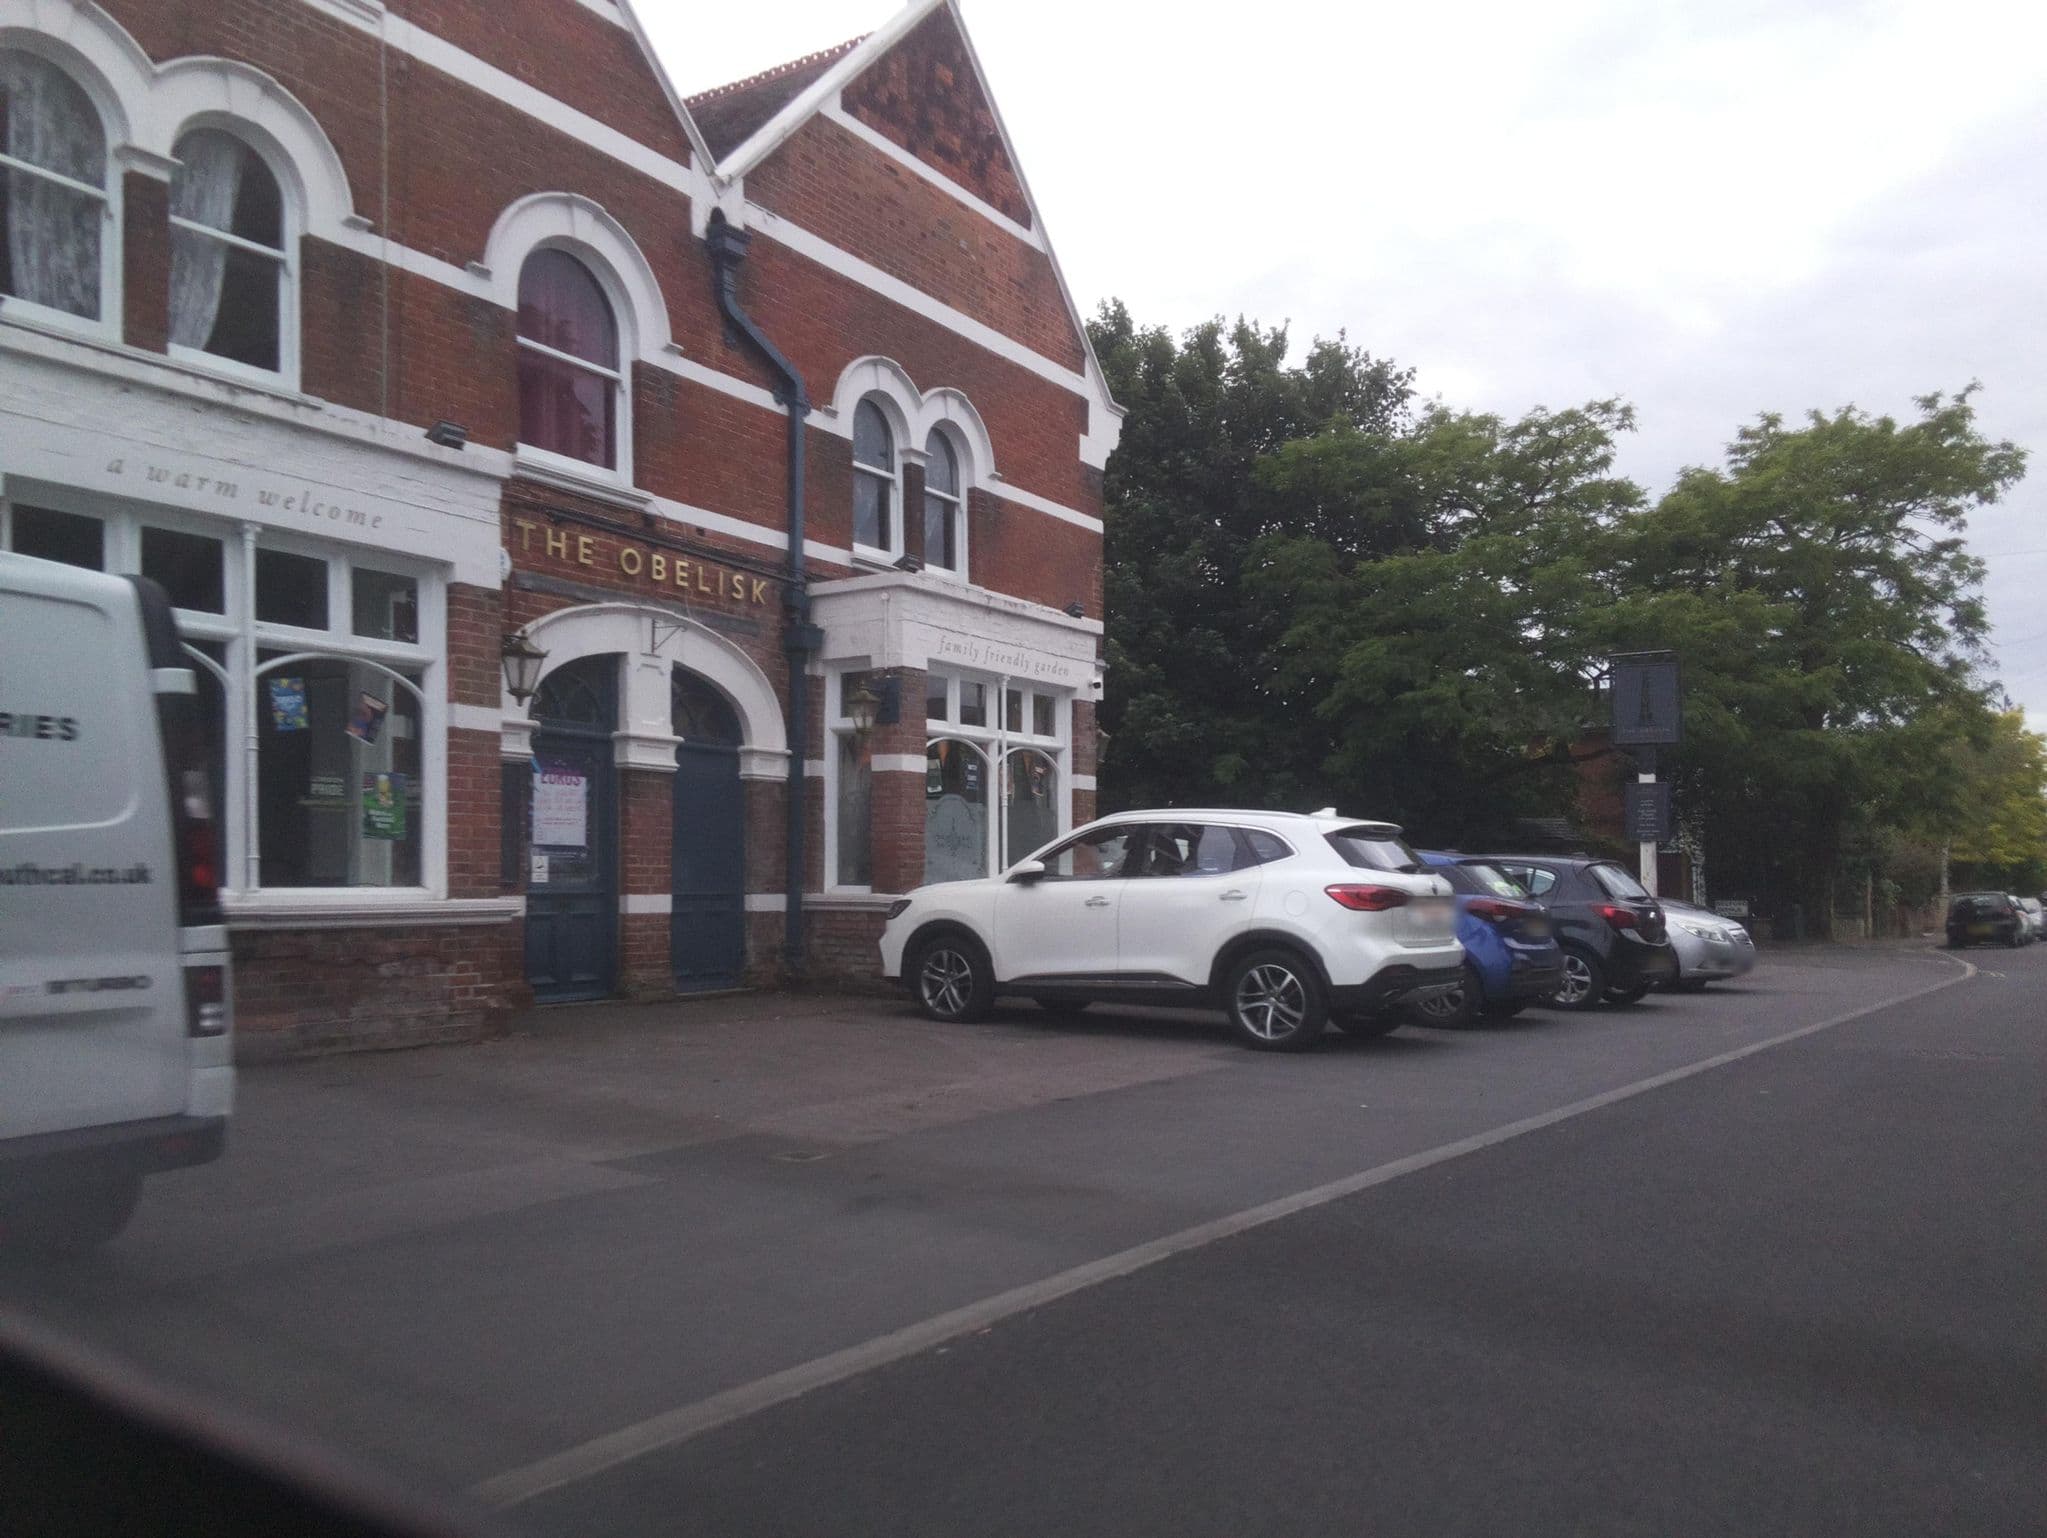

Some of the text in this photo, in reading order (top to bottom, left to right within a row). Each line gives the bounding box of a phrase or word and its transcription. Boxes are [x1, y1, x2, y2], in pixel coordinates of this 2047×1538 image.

[106, 455, 385, 529] a warm welcome
[515, 520, 769, 605] THE OBELISK
[936, 635, 1070, 677] family friendly garden
